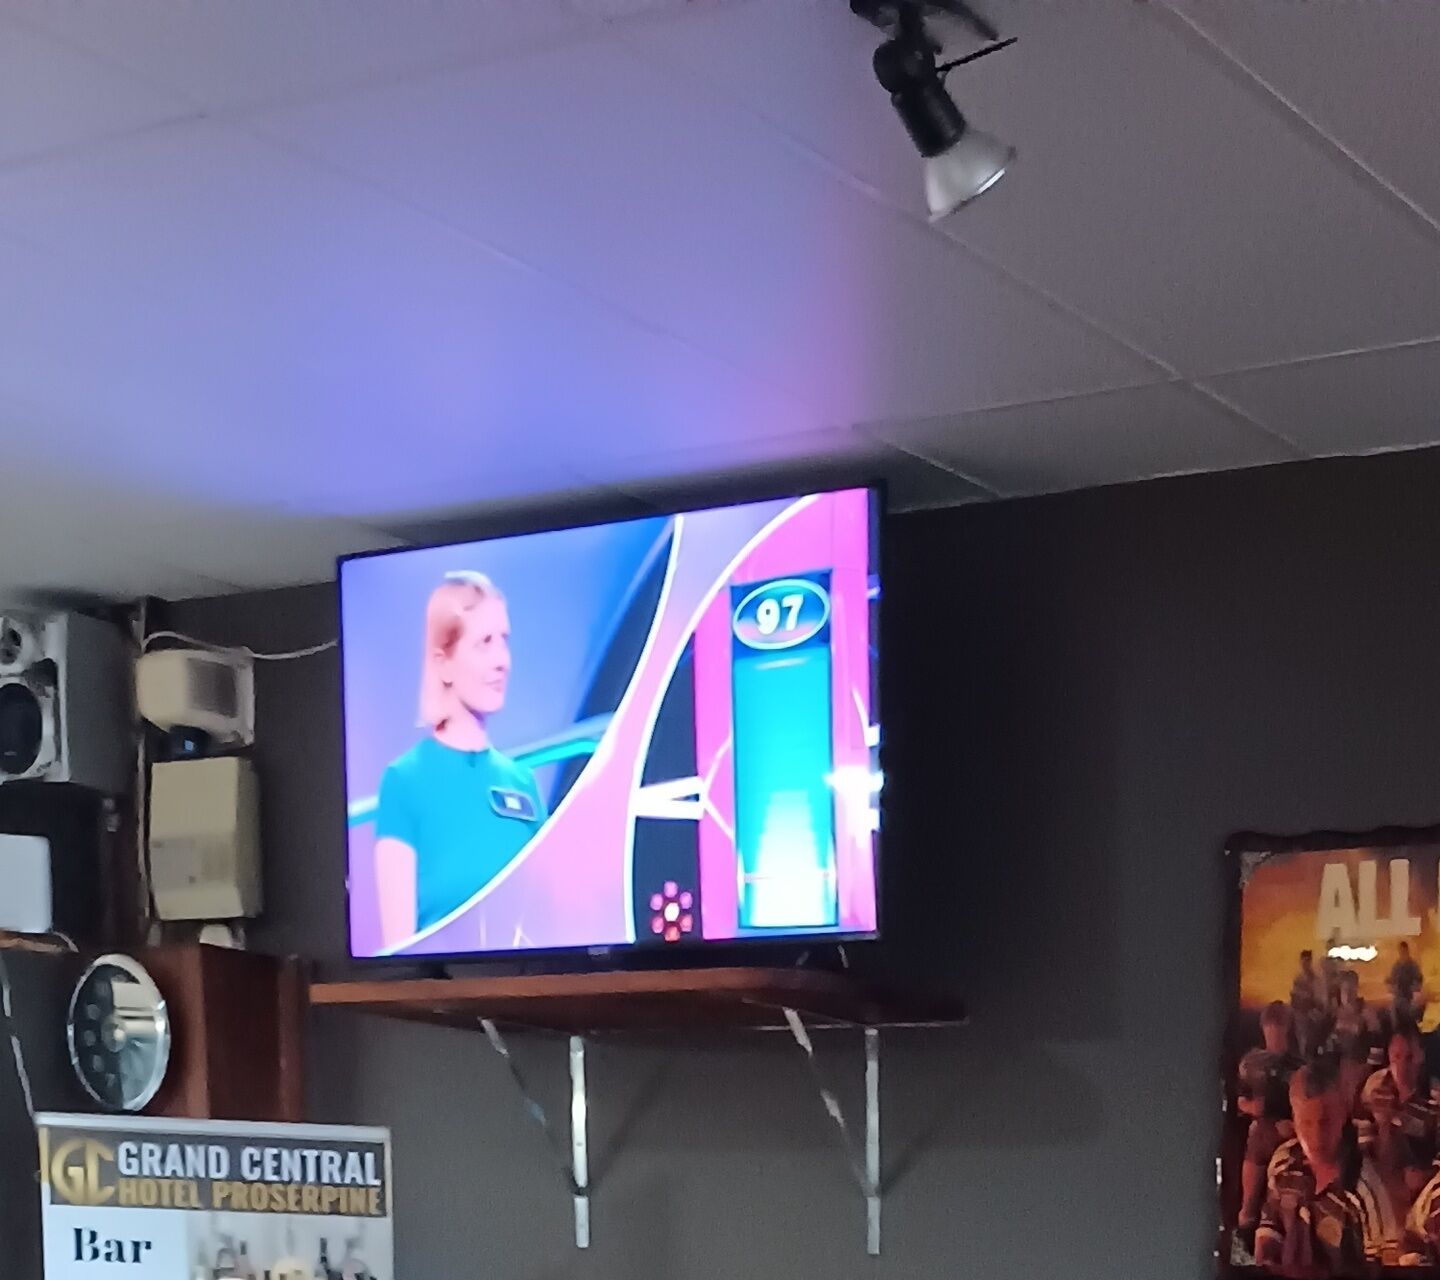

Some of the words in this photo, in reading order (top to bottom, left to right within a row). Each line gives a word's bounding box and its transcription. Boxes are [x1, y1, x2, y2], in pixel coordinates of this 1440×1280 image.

[756, 593, 804, 634] 97
[1316, 857, 1422, 940] ALL
[118, 1140, 230, 1180] GRAND
[241, 1147, 382, 1186] CENTRAL
[119, 1178, 202, 1208] HOTEL
[213, 1184, 382, 1214] PROSERPINE
[73, 1227, 152, 1264] Bar
